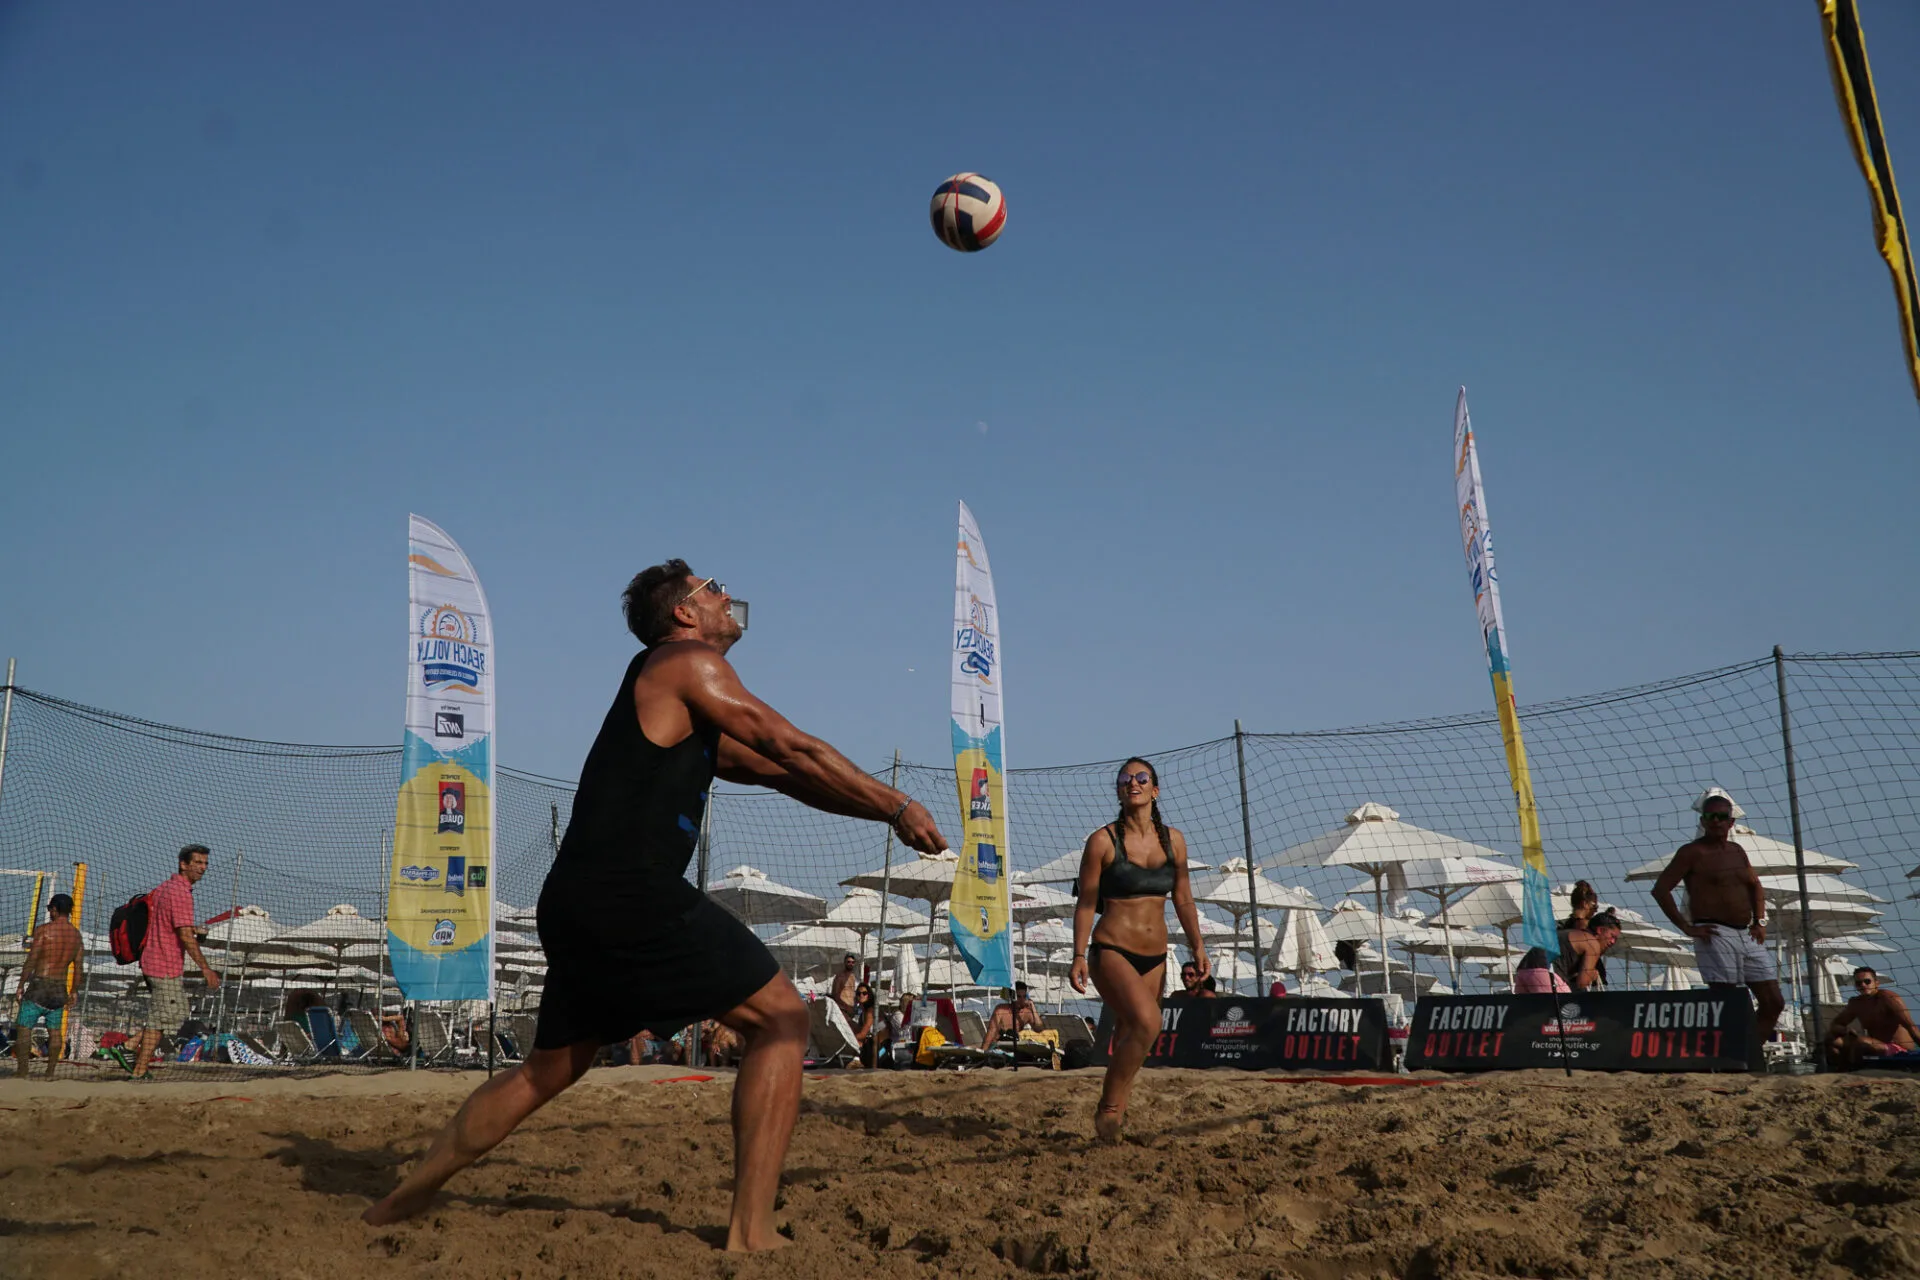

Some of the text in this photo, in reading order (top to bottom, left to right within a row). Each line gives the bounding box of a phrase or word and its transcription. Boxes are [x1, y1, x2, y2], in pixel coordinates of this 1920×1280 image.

[1286, 1008, 1362, 1033] FACTORY
[1429, 1004, 1509, 1030] FACTORY
[1633, 1001, 1724, 1029] FACTORY
[1284, 1033, 1361, 1060] OUTLET
[1423, 1032, 1506, 1058] OUTLET
[1630, 1031, 1723, 1058] OUTLET
